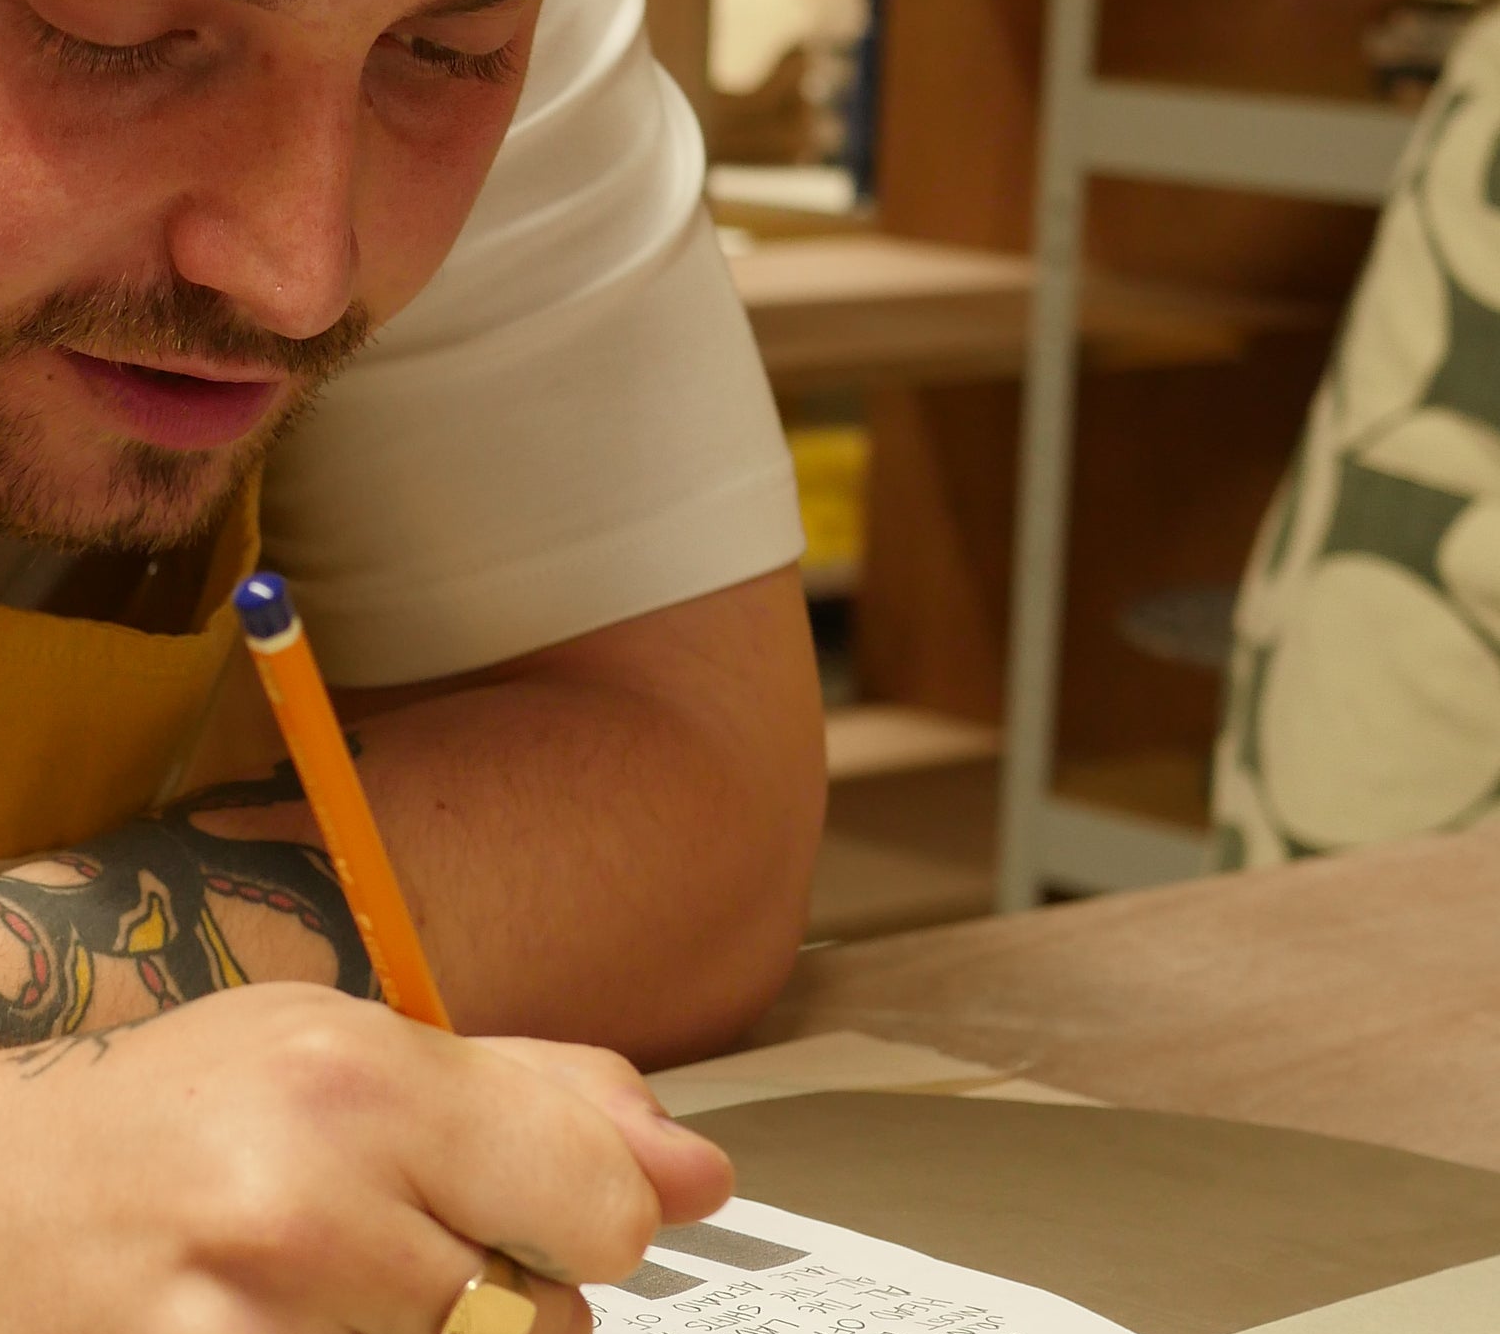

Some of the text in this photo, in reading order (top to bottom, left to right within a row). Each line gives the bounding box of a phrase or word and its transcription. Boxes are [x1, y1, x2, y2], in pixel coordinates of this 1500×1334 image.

[671, 1280, 765, 1314] AFRAID
[768, 1286, 827, 1308] THE
[853, 1284, 912, 1301] ALL
[797, 1297, 863, 1315] THE
[868, 1294, 954, 1321] HEAD
[913, 1305, 989, 1331] MOST
